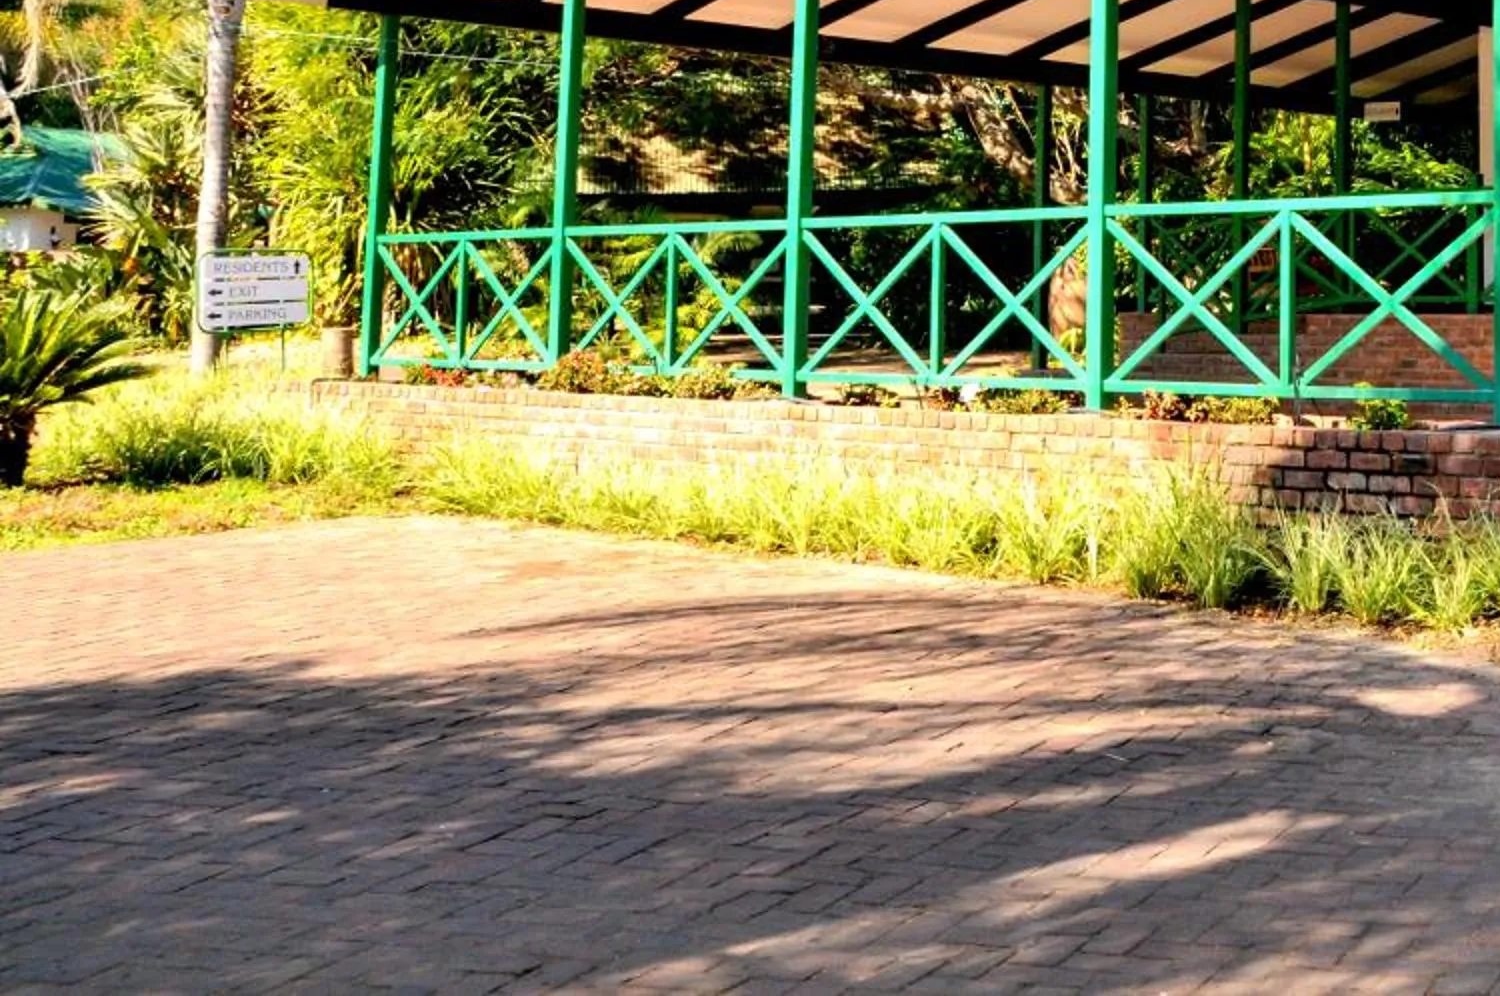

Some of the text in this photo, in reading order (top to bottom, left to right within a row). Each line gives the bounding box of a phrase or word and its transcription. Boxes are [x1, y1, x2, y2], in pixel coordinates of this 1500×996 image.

[213, 261, 289, 274] RESIDENTS
[228, 286, 258, 298] EXIT
[228, 308, 287, 321] PARKING
